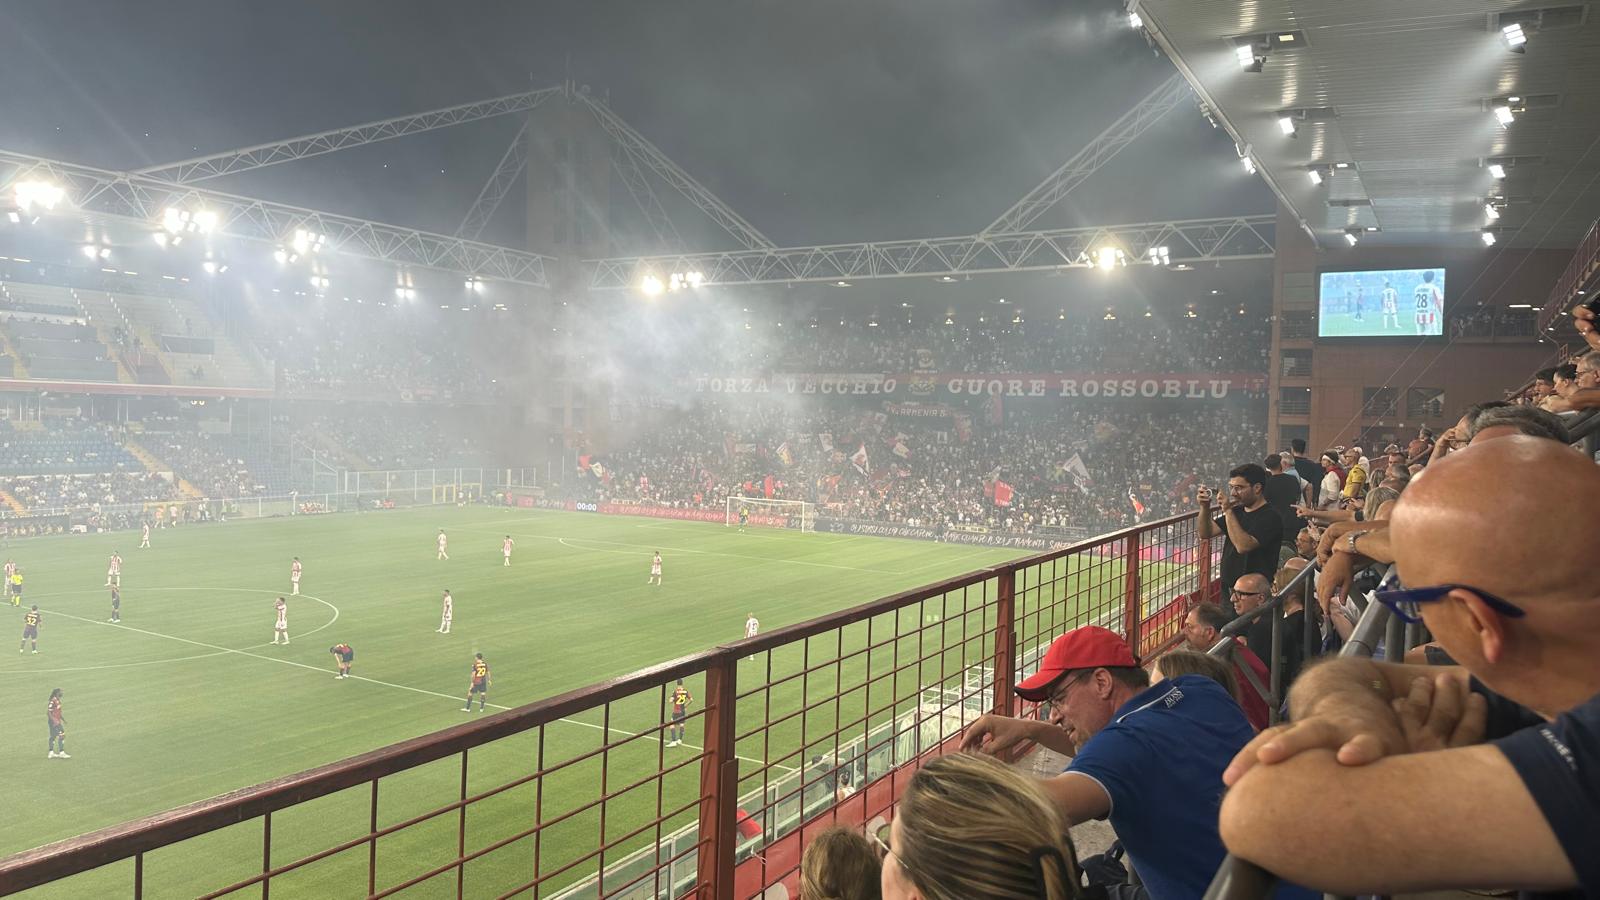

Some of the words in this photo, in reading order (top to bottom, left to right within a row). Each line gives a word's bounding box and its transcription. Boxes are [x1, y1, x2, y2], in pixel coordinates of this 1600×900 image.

[1415, 293, 1428, 309] 28
[695, 378, 770, 394] FORZA
[784, 378, 898, 395] VECCHIO
[947, 378, 1046, 397] CUORE
[1059, 378, 1232, 399] ROSSOBLU
[576, 502, 597, 512] 00:00
[26, 616, 37, 626] 32
[1164, 689, 1183, 708] BOSS
